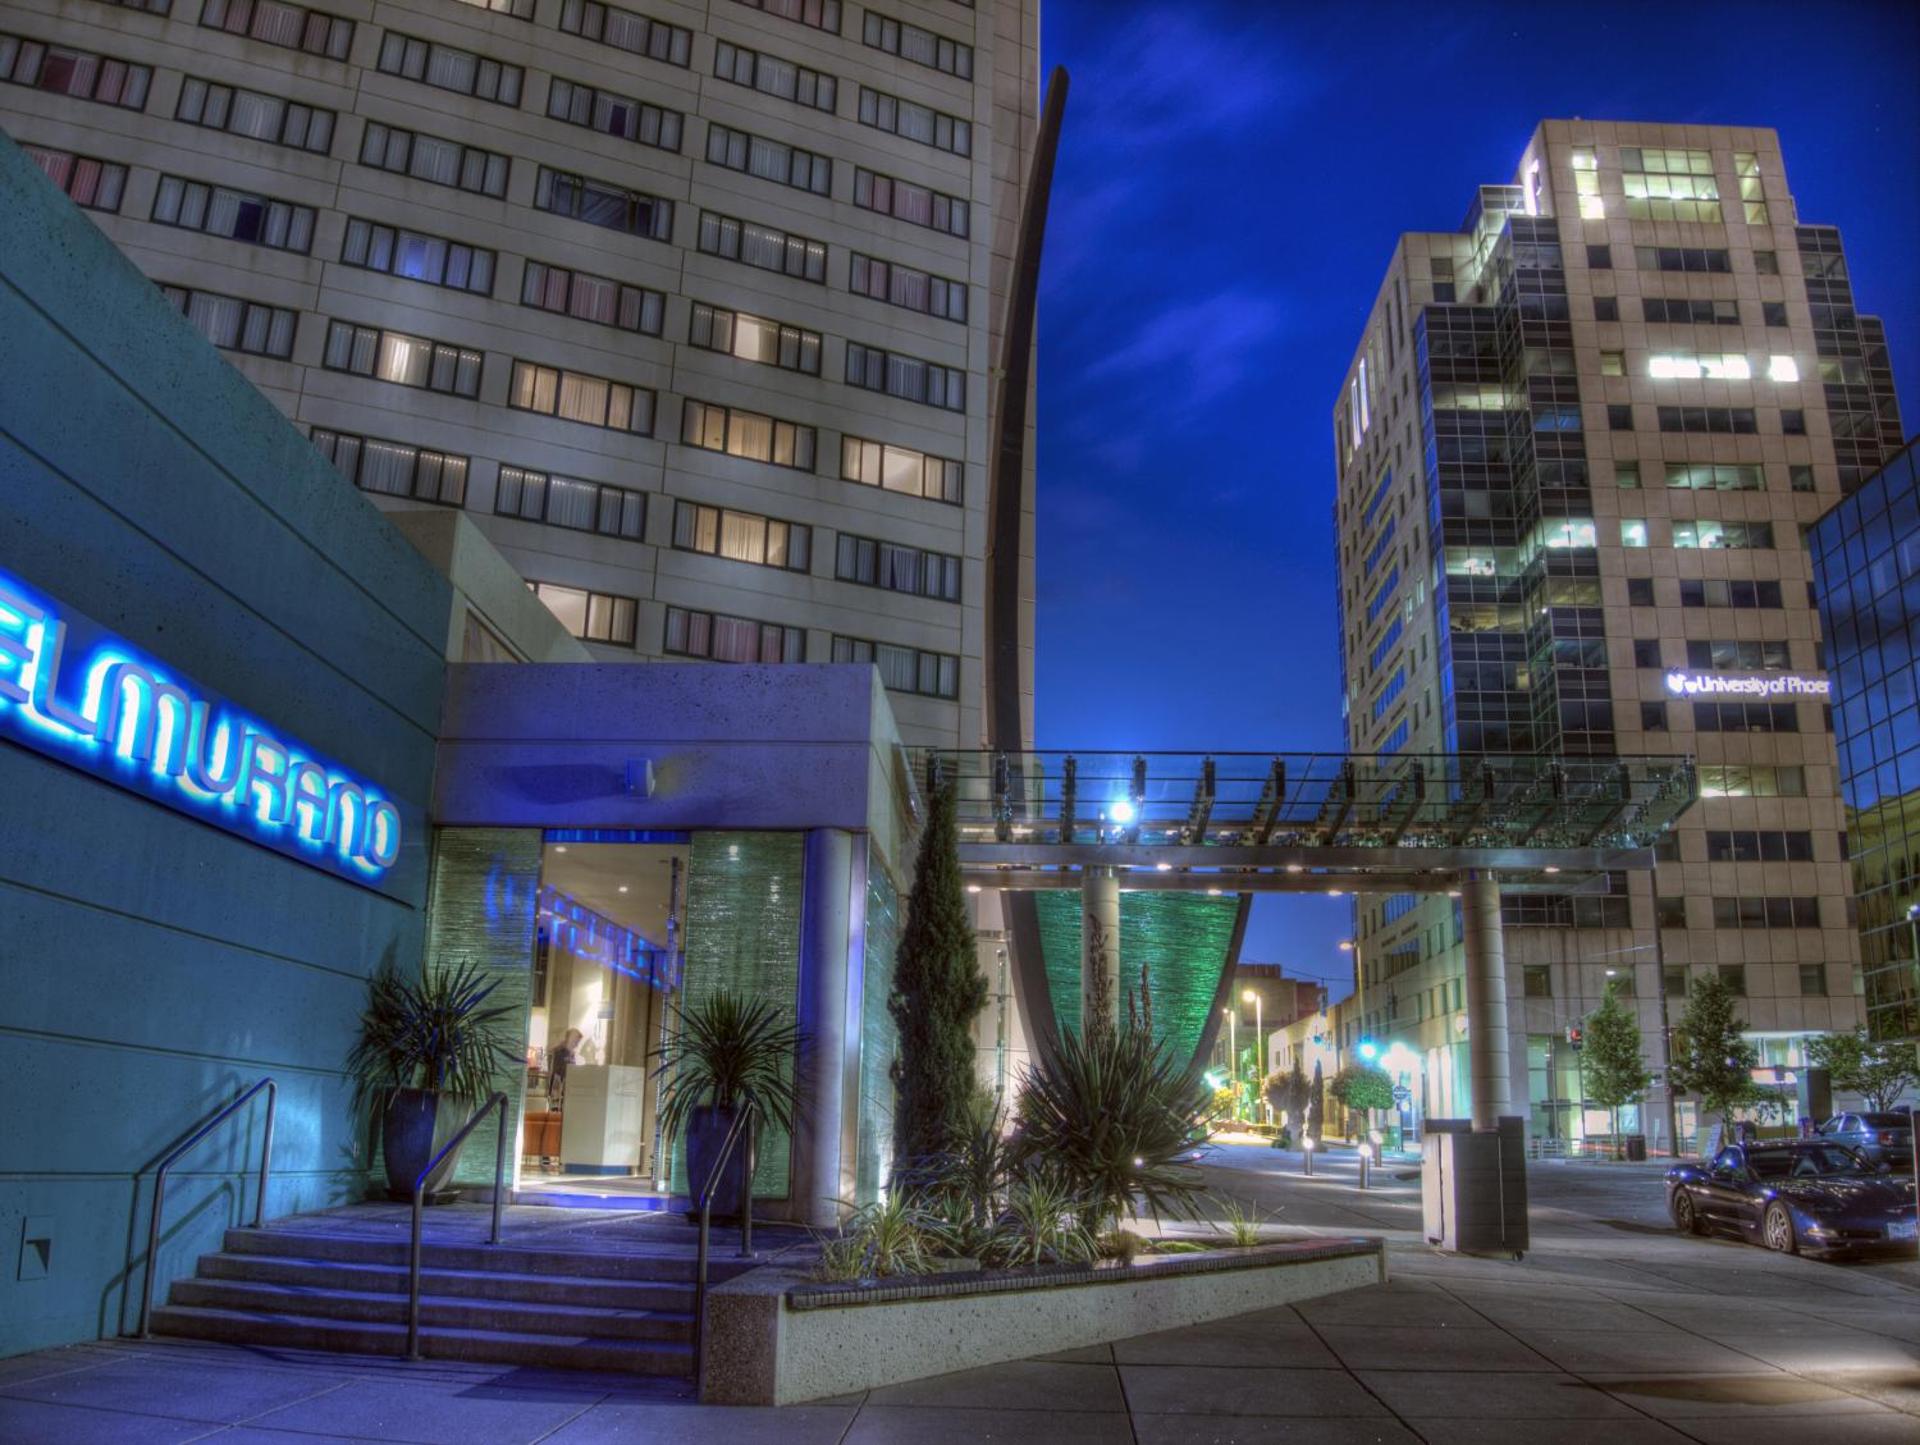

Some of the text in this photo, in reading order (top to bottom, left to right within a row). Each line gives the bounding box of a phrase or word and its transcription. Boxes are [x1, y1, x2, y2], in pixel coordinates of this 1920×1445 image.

[1698, 676, 1769, 696] University
[1770, 676, 1787, 693] of
[94, 661, 400, 868] MURANO
